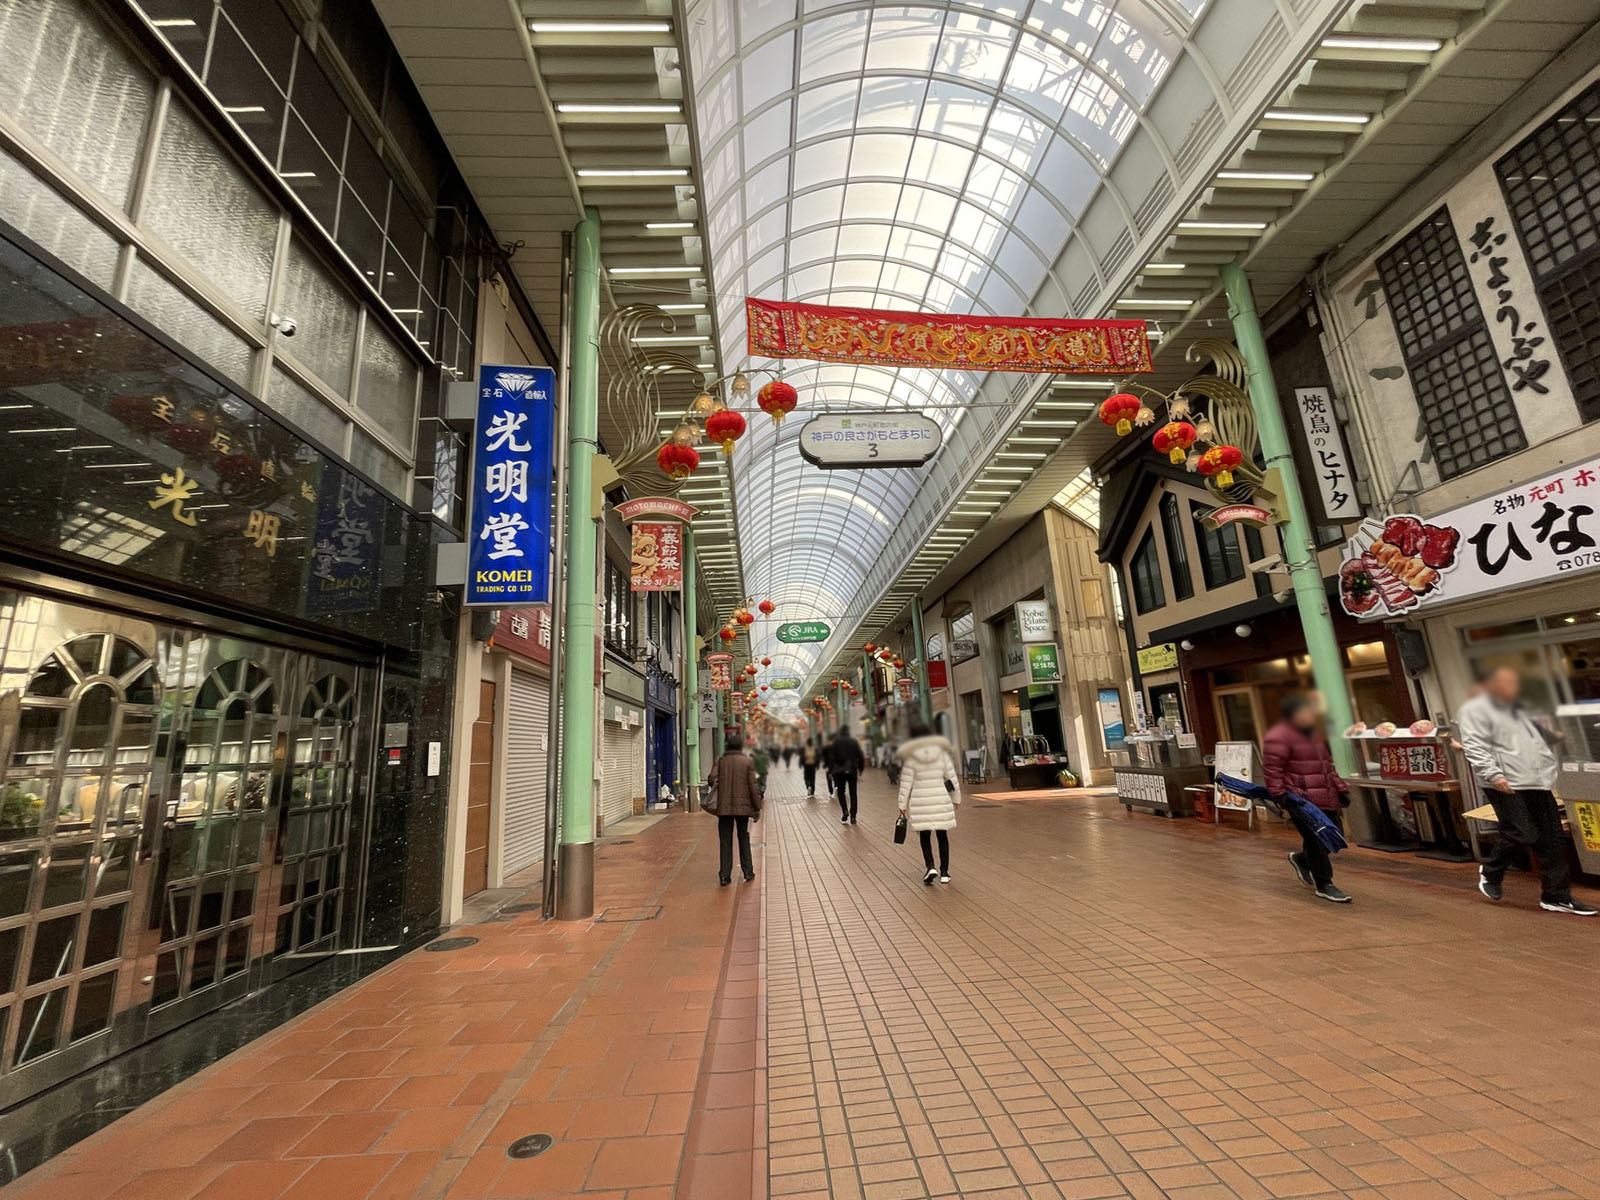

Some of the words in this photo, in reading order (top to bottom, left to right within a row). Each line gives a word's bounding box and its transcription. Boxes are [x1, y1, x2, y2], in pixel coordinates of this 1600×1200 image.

[811, 429, 931, 442] 神戸の良さがもとまちに
[868, 443, 879, 457] 3
[1302, 394, 1349, 511] 焼鳥のヒナタ
[480, 410, 533, 560] 光明堂
[1493, 494, 1525, 515] 名物
[1529, 478, 1564, 502] 元町
[1573, 469, 1600, 487] ホ
[1467, 501, 1597, 575] ひな
[661, 533, 680, 570] 春節祭
[476, 570, 532, 583] KOMEI
[476, 585, 505, 593] TRADING
[520, 584, 533, 592] LTD
[1022, 609, 1045, 617] Kobe
[1022, 617, 1049, 625] Pilates
[803, 626, 818, 634] JRA
[1024, 624, 1047, 633] Space
